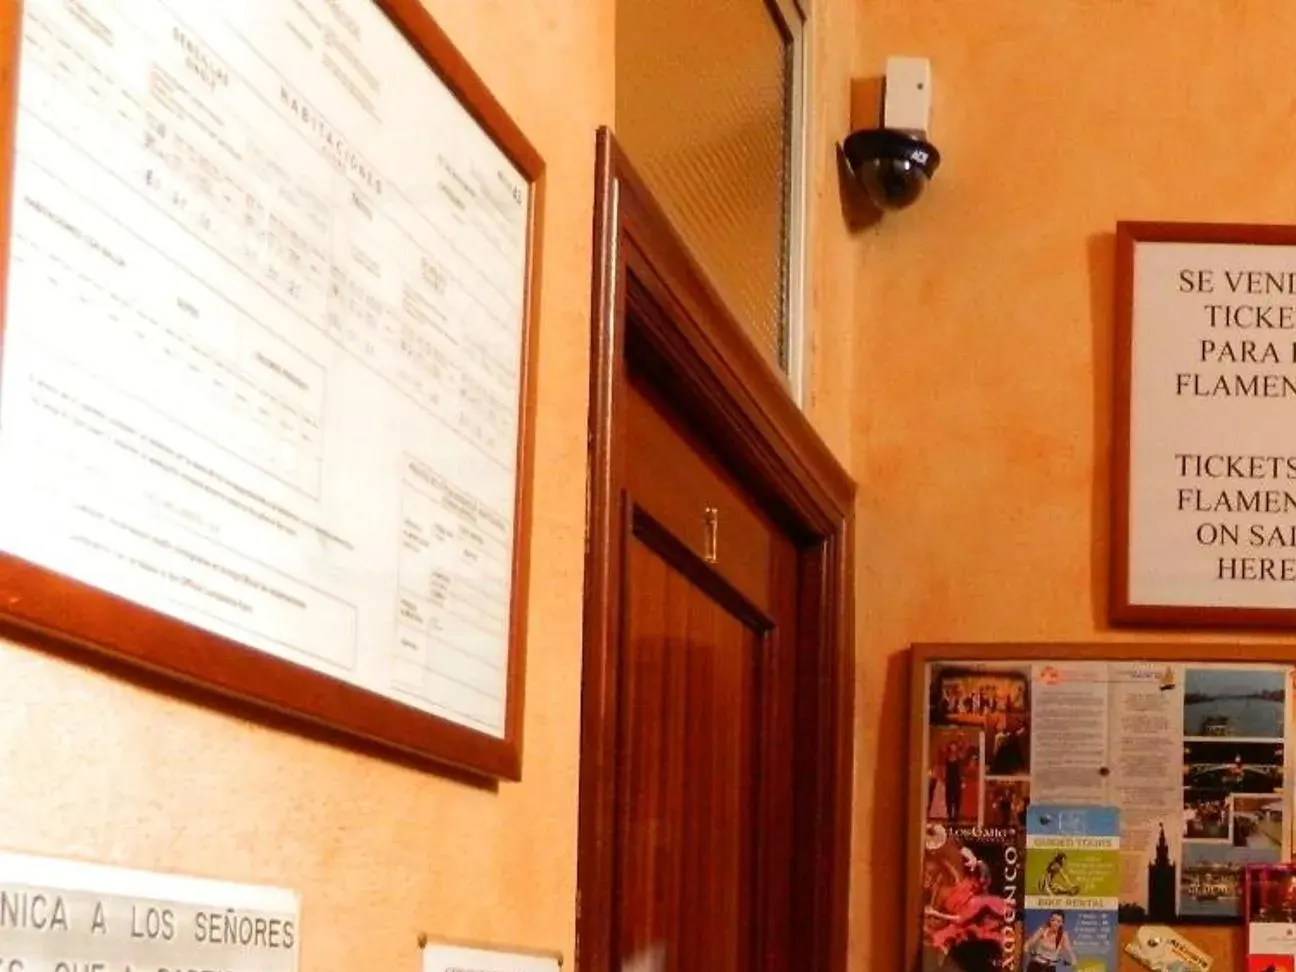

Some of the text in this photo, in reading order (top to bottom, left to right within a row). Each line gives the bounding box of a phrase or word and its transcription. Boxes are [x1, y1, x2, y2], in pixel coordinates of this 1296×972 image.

[1178, 269, 1214, 293] SE
[1200, 339, 1280, 364] PARA
[1196, 523, 1239, 546] ON
[91, 901, 107, 934] A
[131, 906, 175, 940] LOS
[194, 908, 295, 949] SEÑORES
